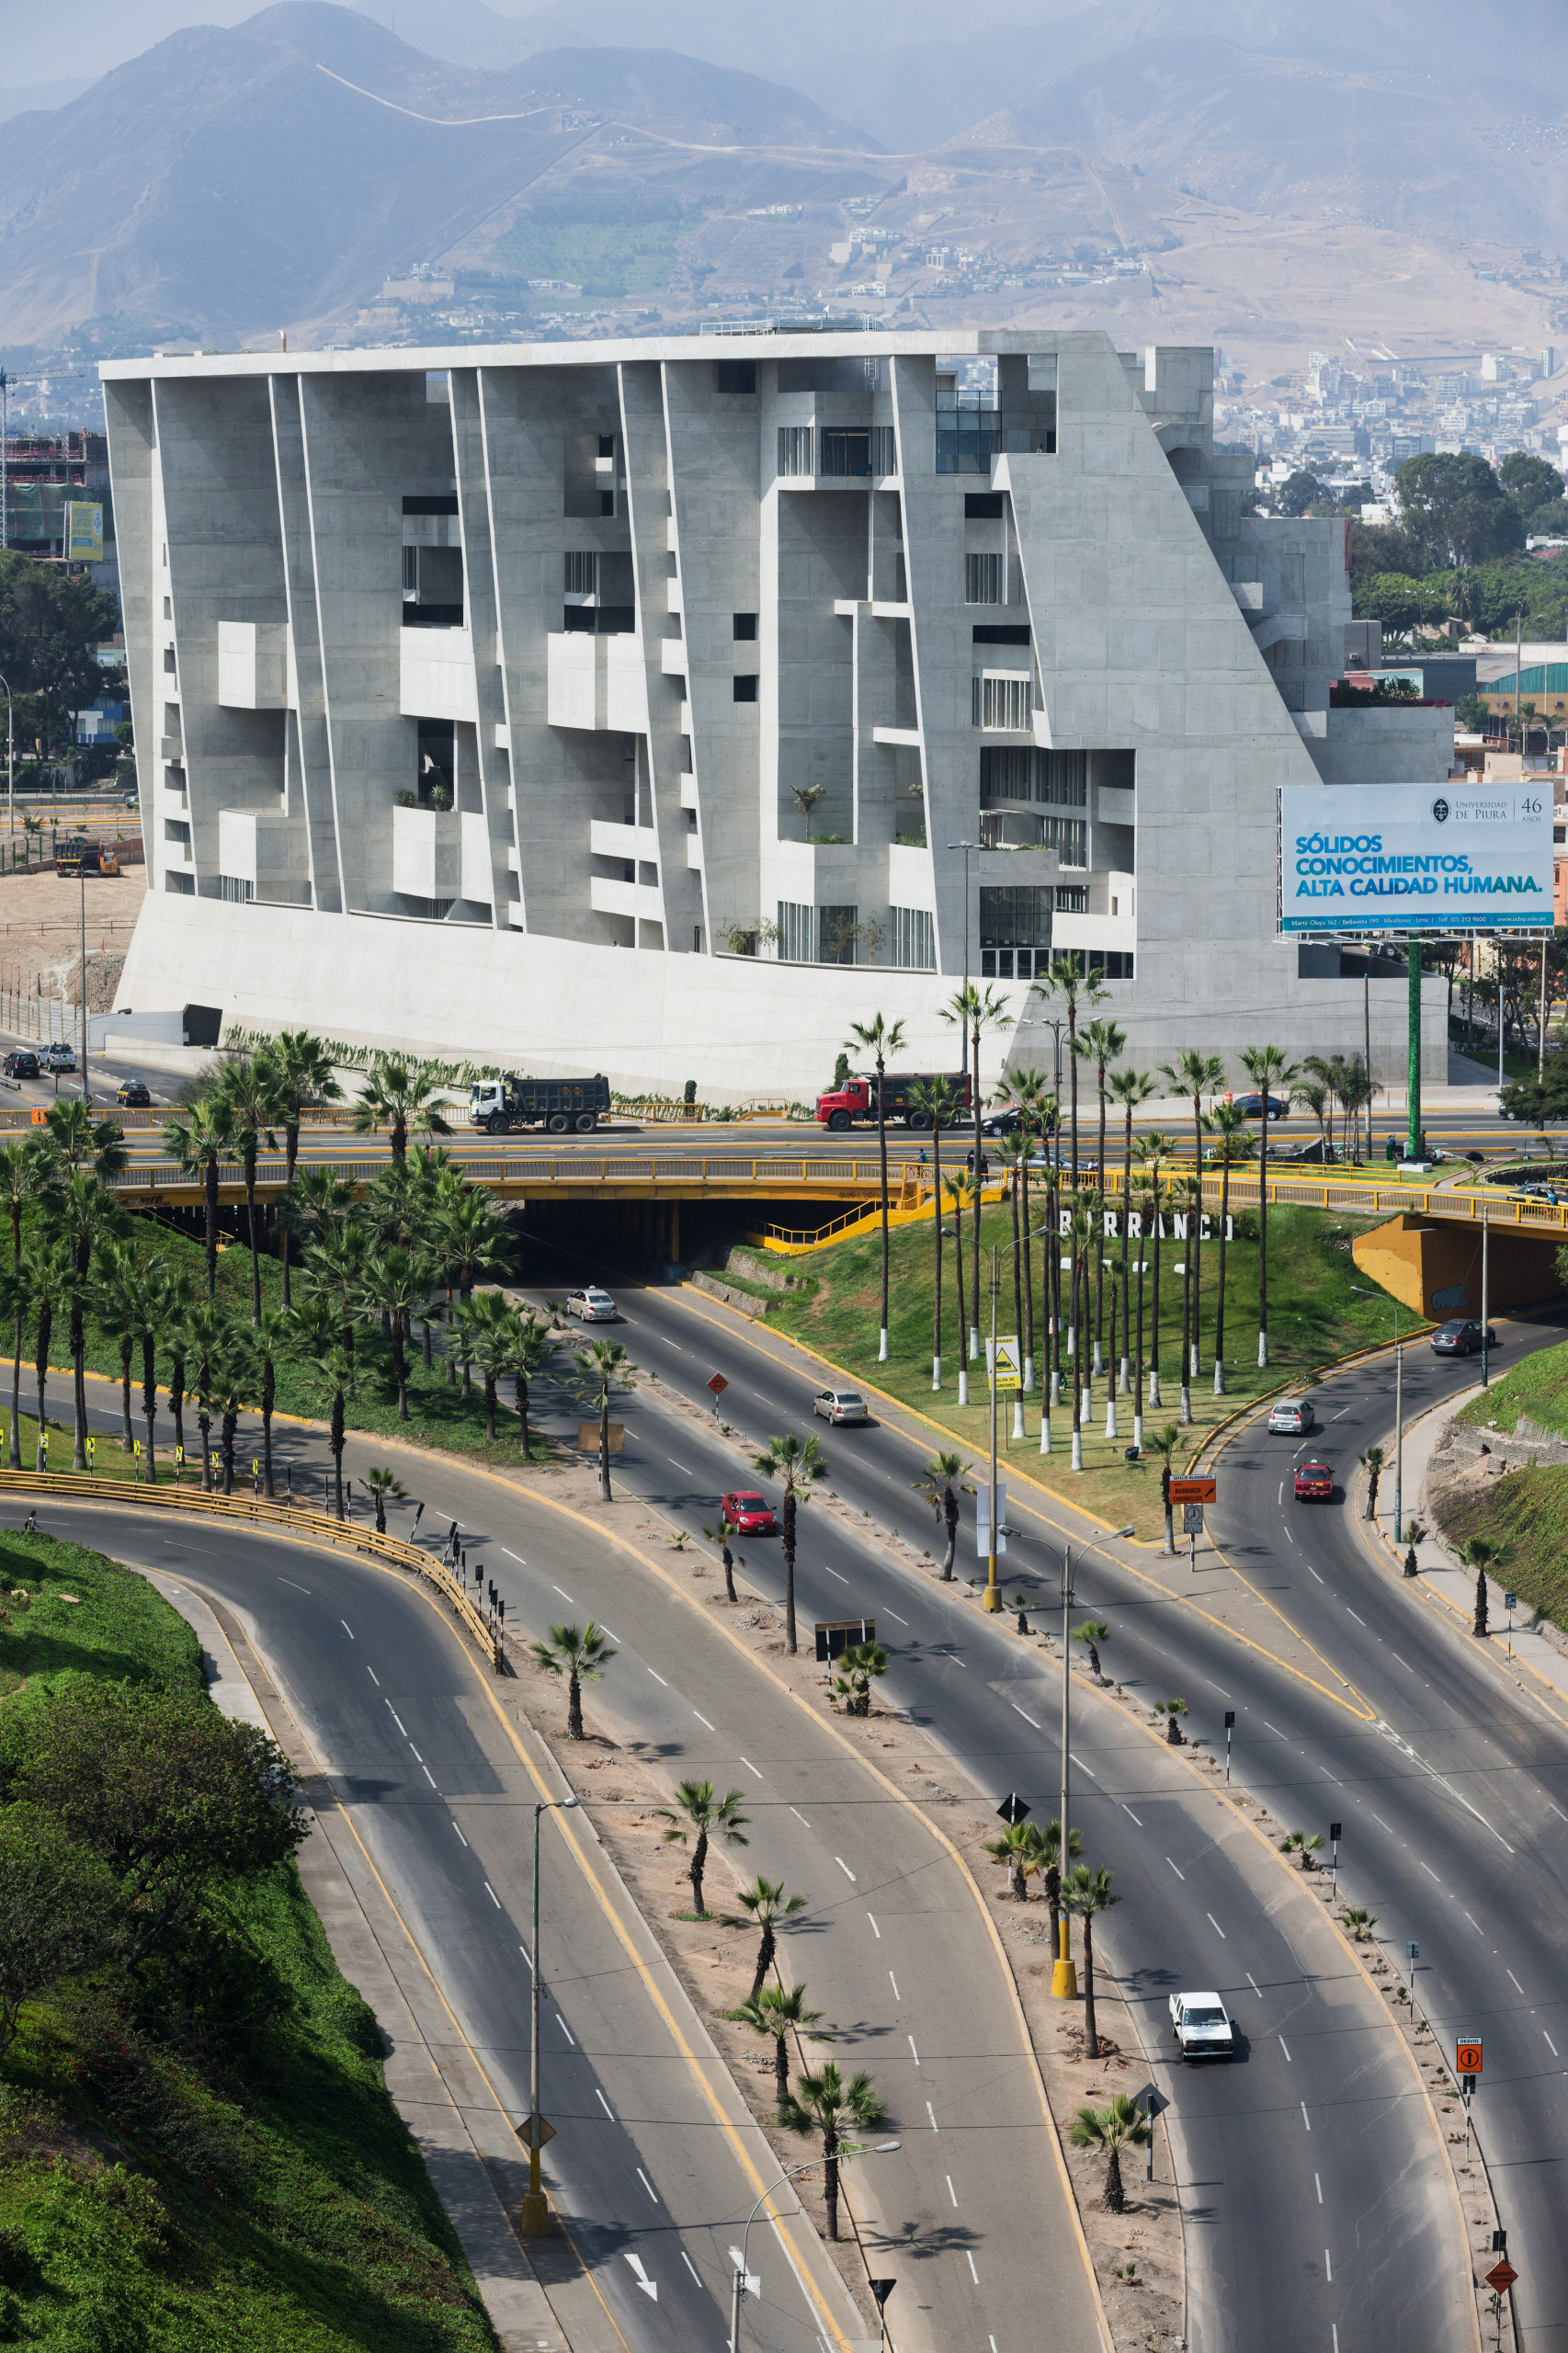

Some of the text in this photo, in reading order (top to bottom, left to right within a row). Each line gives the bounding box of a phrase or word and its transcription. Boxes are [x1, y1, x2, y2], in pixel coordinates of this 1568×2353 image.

[1456, 809, 1507, 820] DE PIURA
[1521, 797, 1542, 813] 46
[1295, 832, 1382, 855] SÓLIDOS
[1295, 855, 1473, 876] CONOCIMIENTOS,
[1295, 876, 1543, 897] ALTA CALIDAD HUMANA.
